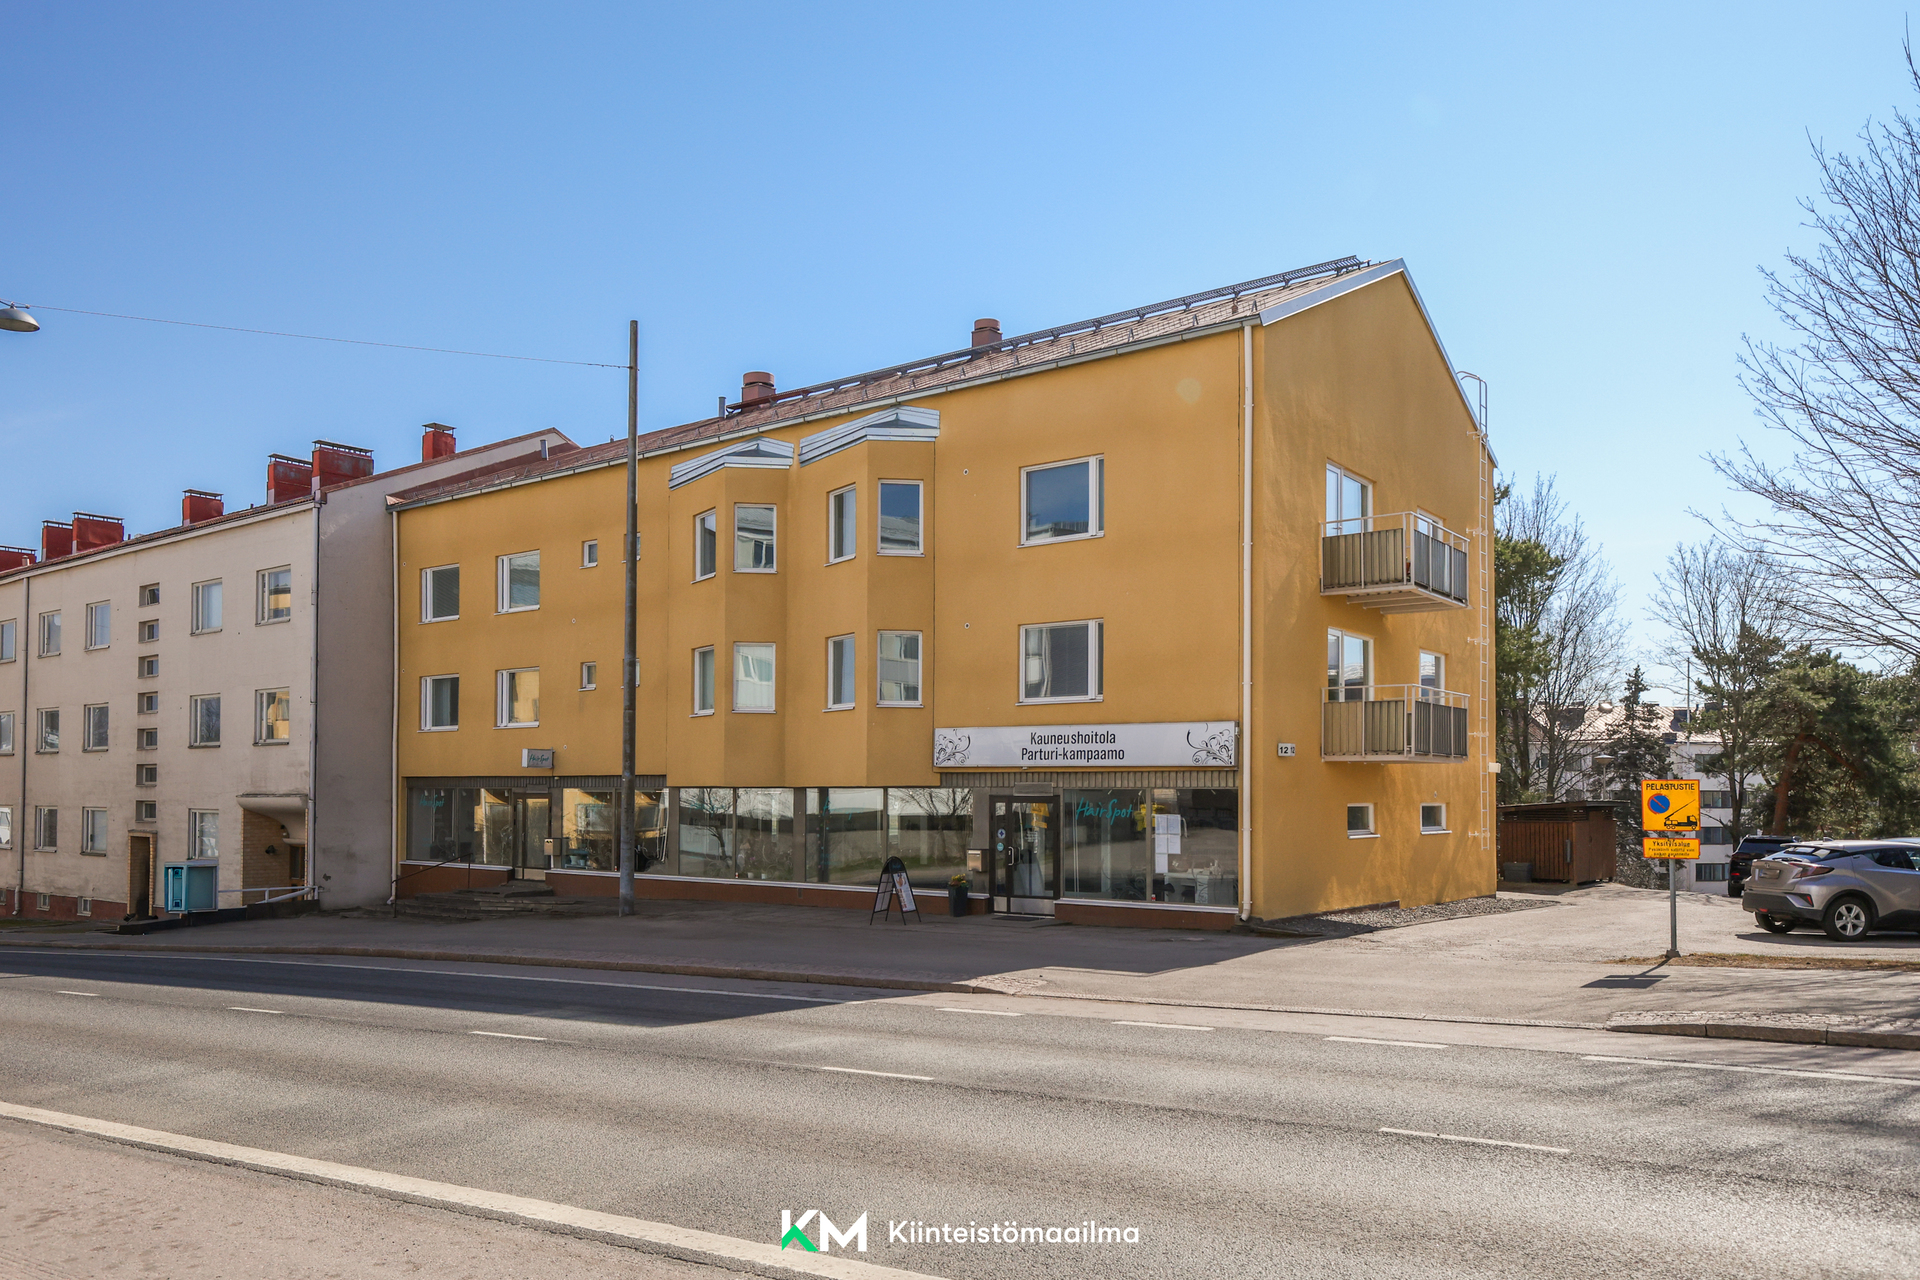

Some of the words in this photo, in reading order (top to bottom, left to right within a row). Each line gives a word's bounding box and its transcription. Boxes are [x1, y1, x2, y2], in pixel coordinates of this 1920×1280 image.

[1030, 730, 1116, 745] Kauneushoitola
[1021, 747, 1125, 763] Parturi-kampaamo
[1279, 746, 1289, 754] 12
[1645, 783, 1696, 791] PELASTUSTIE
